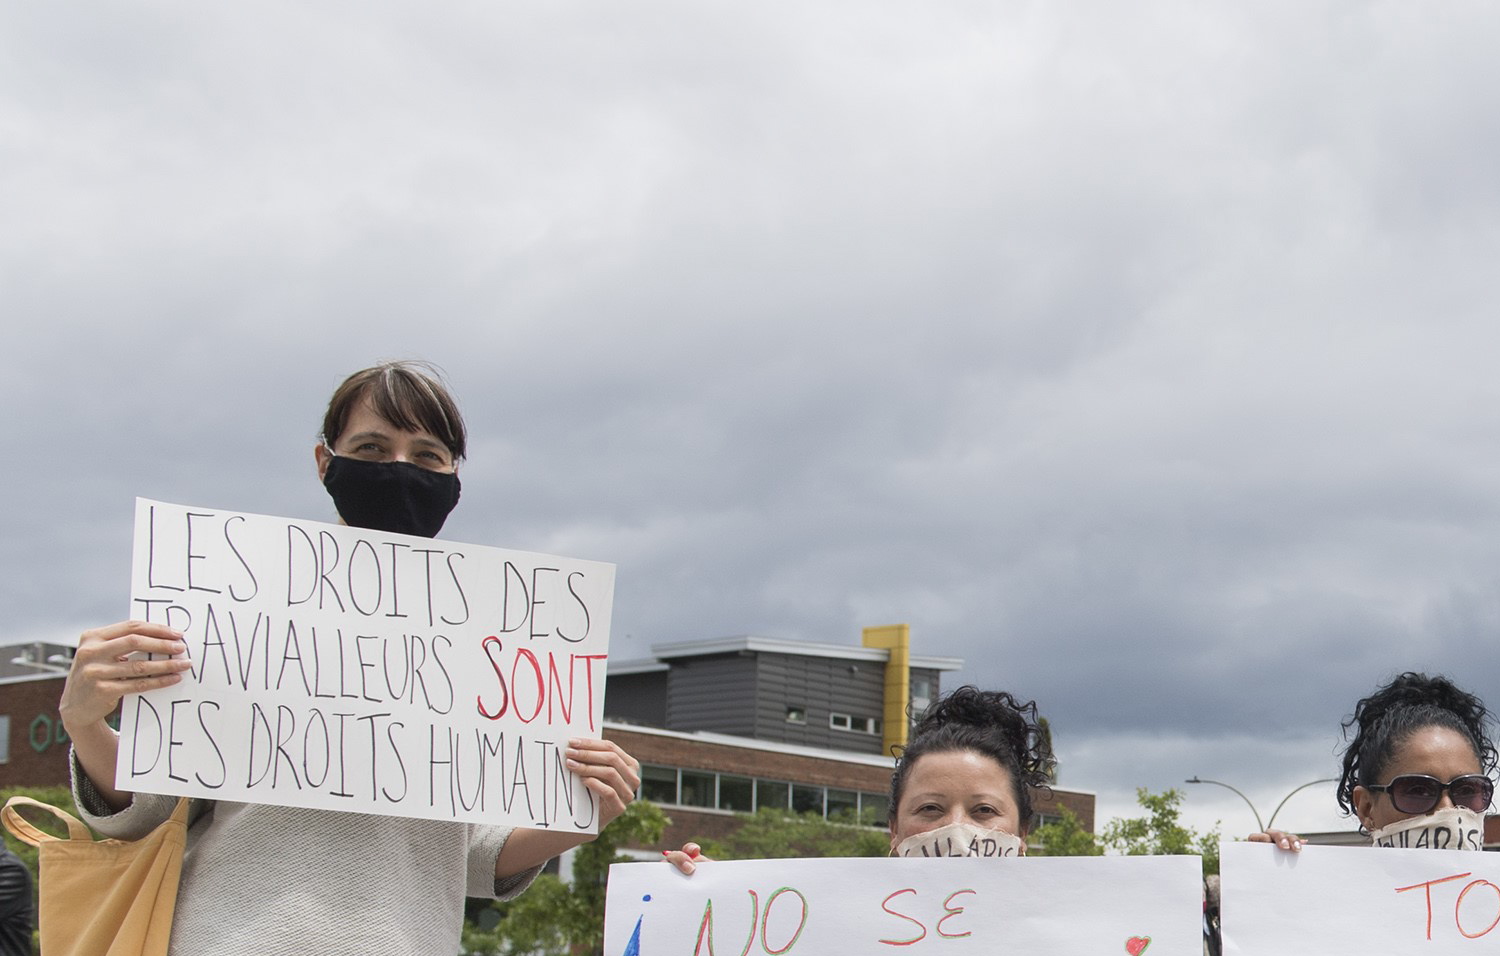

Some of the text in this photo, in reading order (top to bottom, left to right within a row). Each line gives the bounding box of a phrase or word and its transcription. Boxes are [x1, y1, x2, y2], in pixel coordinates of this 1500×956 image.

[148, 505, 591, 643] LES DROITS DES
[134, 598, 608, 733] TRAVIALLEURS SONT
[132, 695, 226, 788] DES
[247, 702, 408, 803] DROITS
[878, 888, 977, 946] SE
